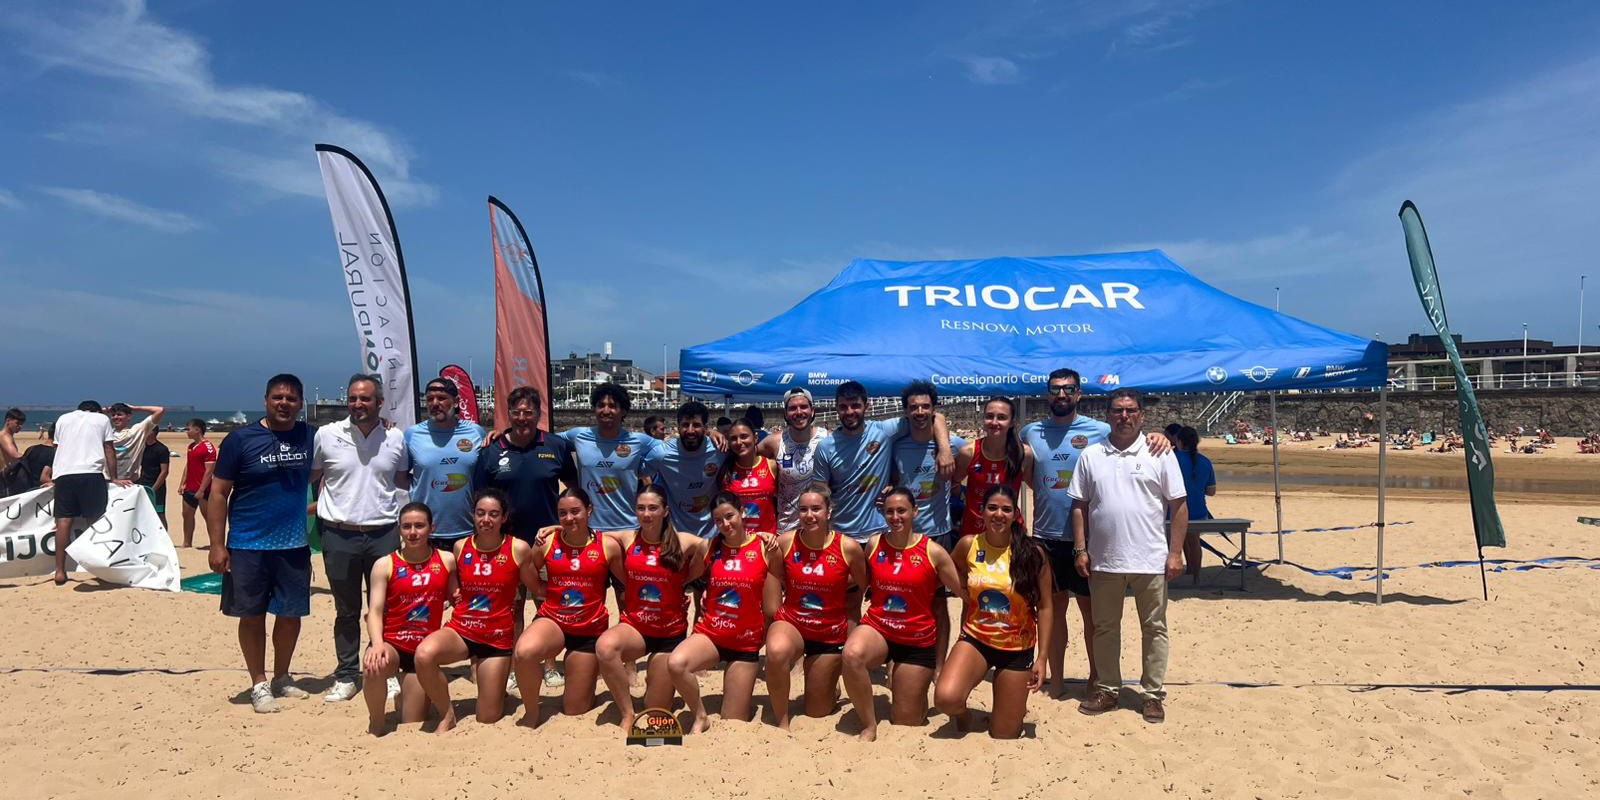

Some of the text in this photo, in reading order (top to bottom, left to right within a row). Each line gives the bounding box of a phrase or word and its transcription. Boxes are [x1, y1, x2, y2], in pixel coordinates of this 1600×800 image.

[884, 282, 1145, 311] TRIOCAR
[941, 319, 1094, 336] RESNOVA MOTOR
[931, 373, 1018, 386] Concesionario
[570, 559, 580, 571] 3
[646, 555, 657, 566] 2
[724, 559, 742, 571] 31
[473, 563, 492, 576] 13
[802, 563, 824, 576] 64
[893, 562, 903, 575] 7
[411, 573, 431, 587] 27
[648, 716, 674, 726] Gijón
